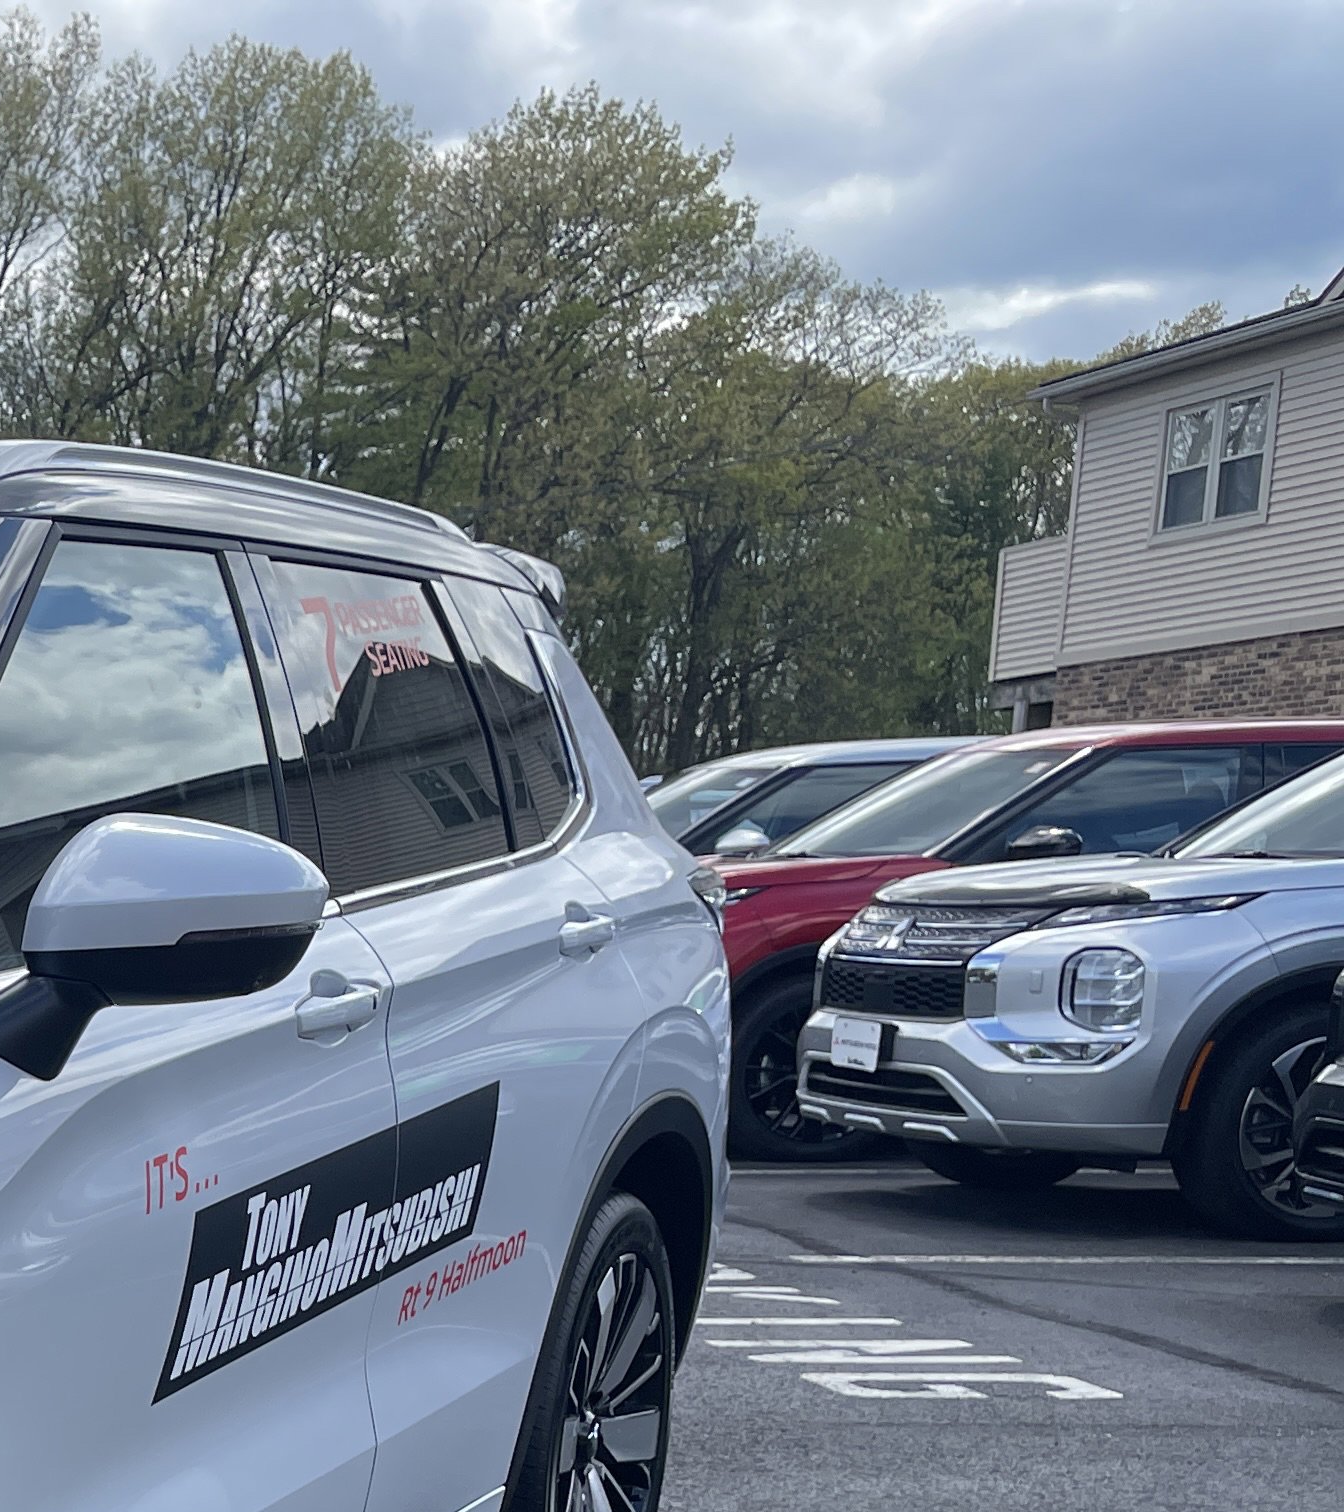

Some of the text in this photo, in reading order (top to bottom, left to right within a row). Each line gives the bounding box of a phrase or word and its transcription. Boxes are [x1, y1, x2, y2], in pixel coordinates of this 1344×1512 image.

[300, 595, 426, 693] 7 PASSENGER
[364, 635, 431, 678] SEATING
[398, 1229, 527, 1336] Rt 9 Halfmoon
